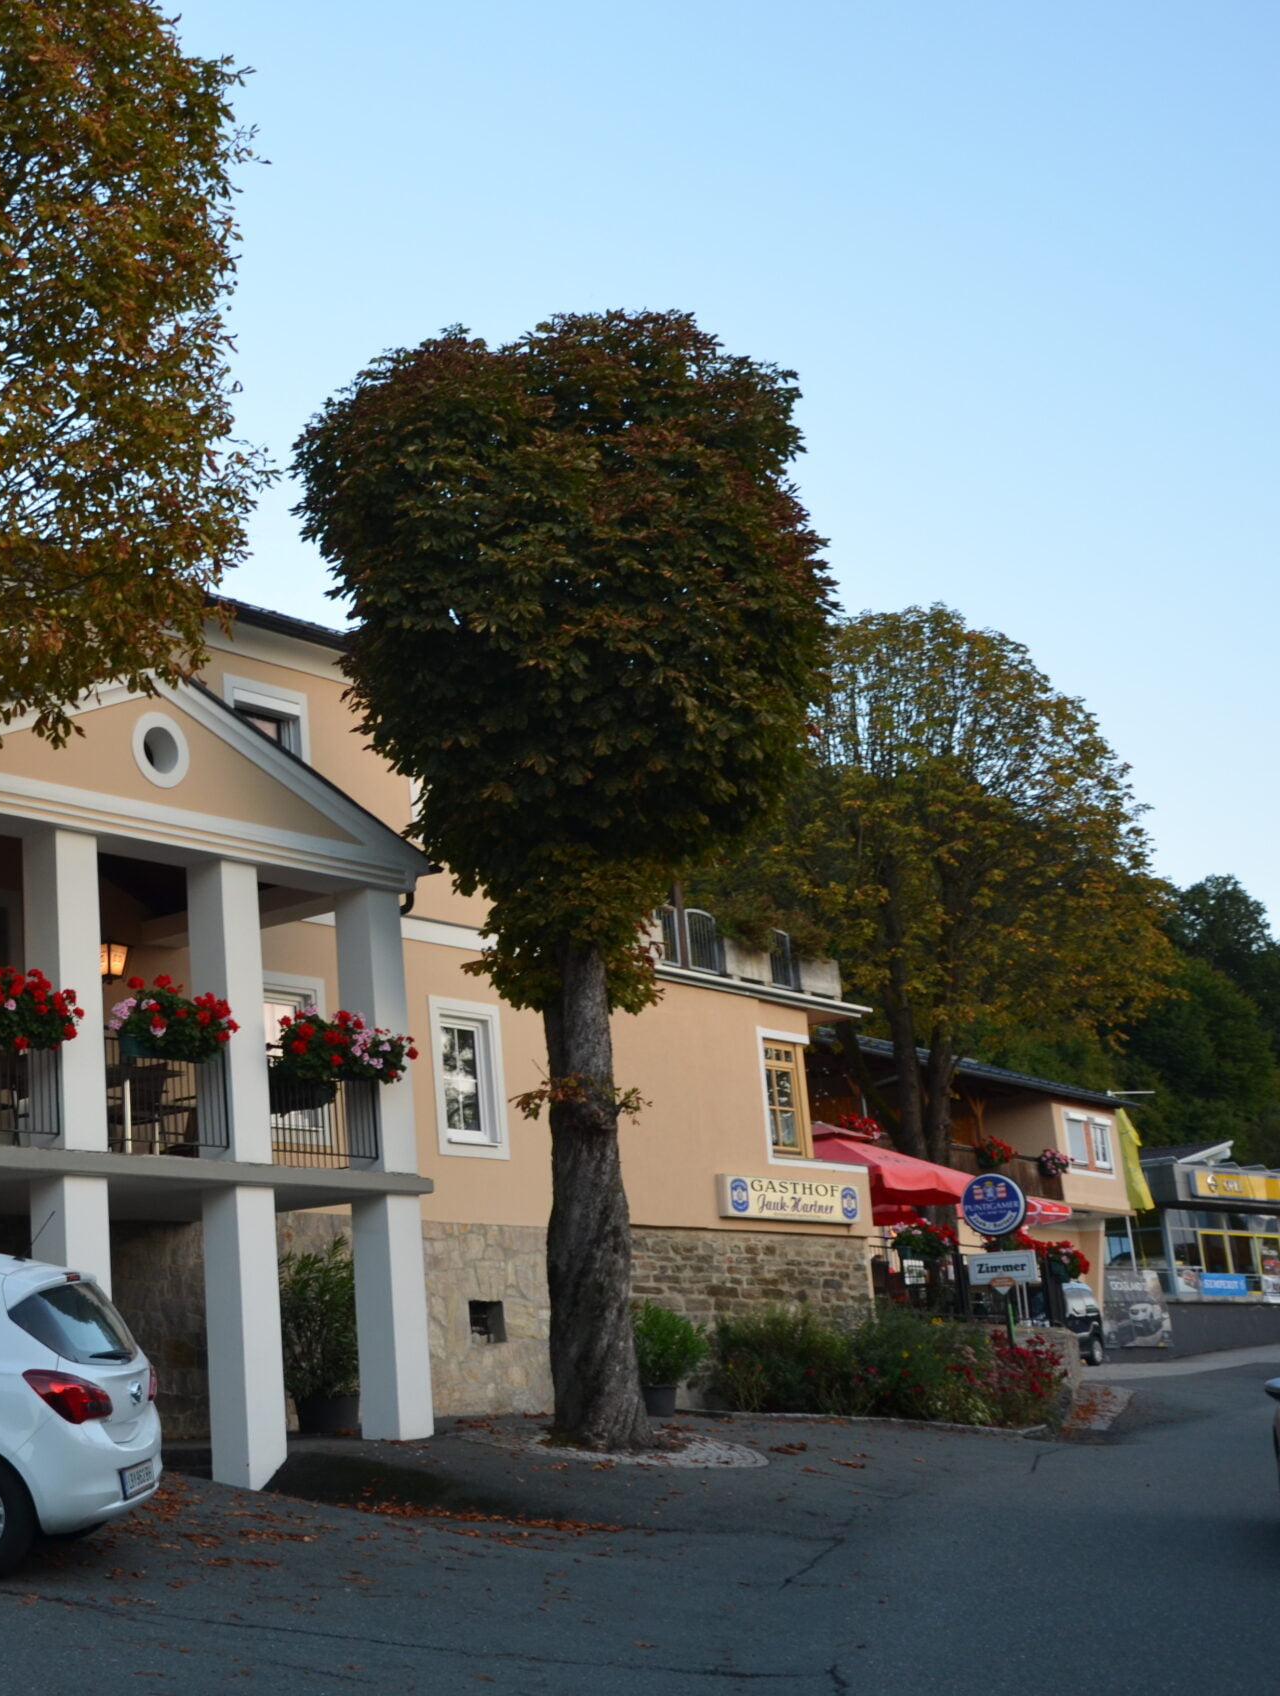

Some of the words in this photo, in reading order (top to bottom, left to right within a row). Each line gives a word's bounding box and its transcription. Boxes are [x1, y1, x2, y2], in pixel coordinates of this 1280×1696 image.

[750, 1179, 840, 1197] GASTHOF
[965, 1201, 1019, 1212] PUNTIGAMER
[976, 1263, 1027, 1274] Zimmer
